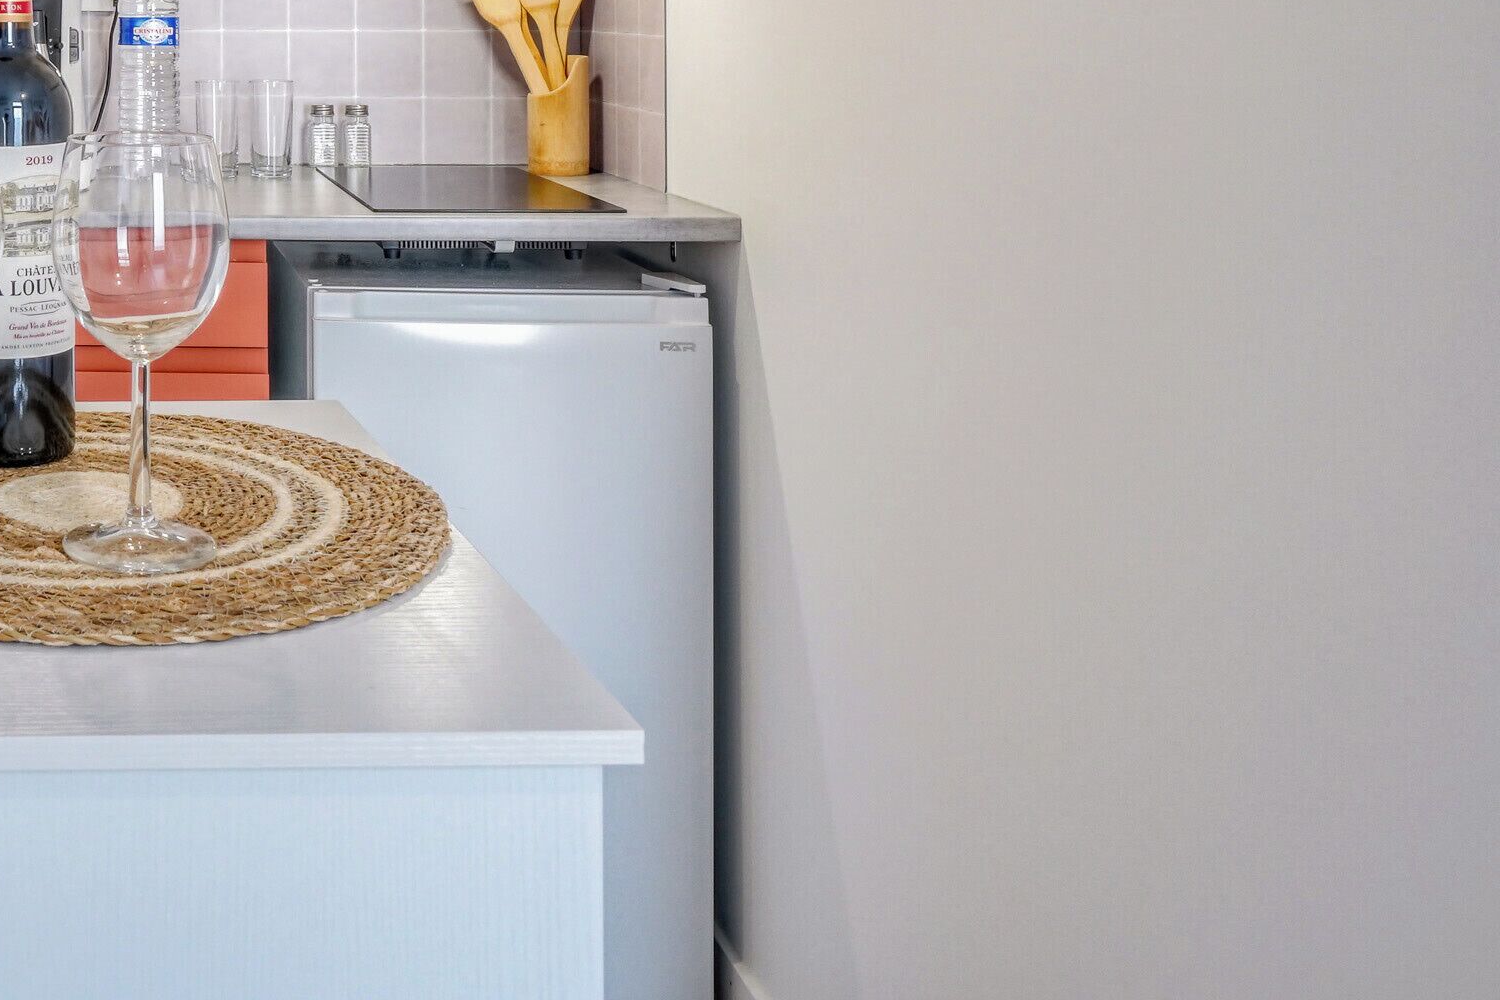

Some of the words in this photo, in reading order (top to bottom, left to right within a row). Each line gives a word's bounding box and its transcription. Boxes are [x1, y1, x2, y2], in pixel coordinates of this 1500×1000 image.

[25, 154, 54, 166] 2019
[16, 264, 56, 277] CHÂTE
[10, 277, 61, 297] LOUV
[9, 305, 37, 313] PESSAC
[8, 323, 29, 331] Grand
[659, 341, 697, 352] FAR
